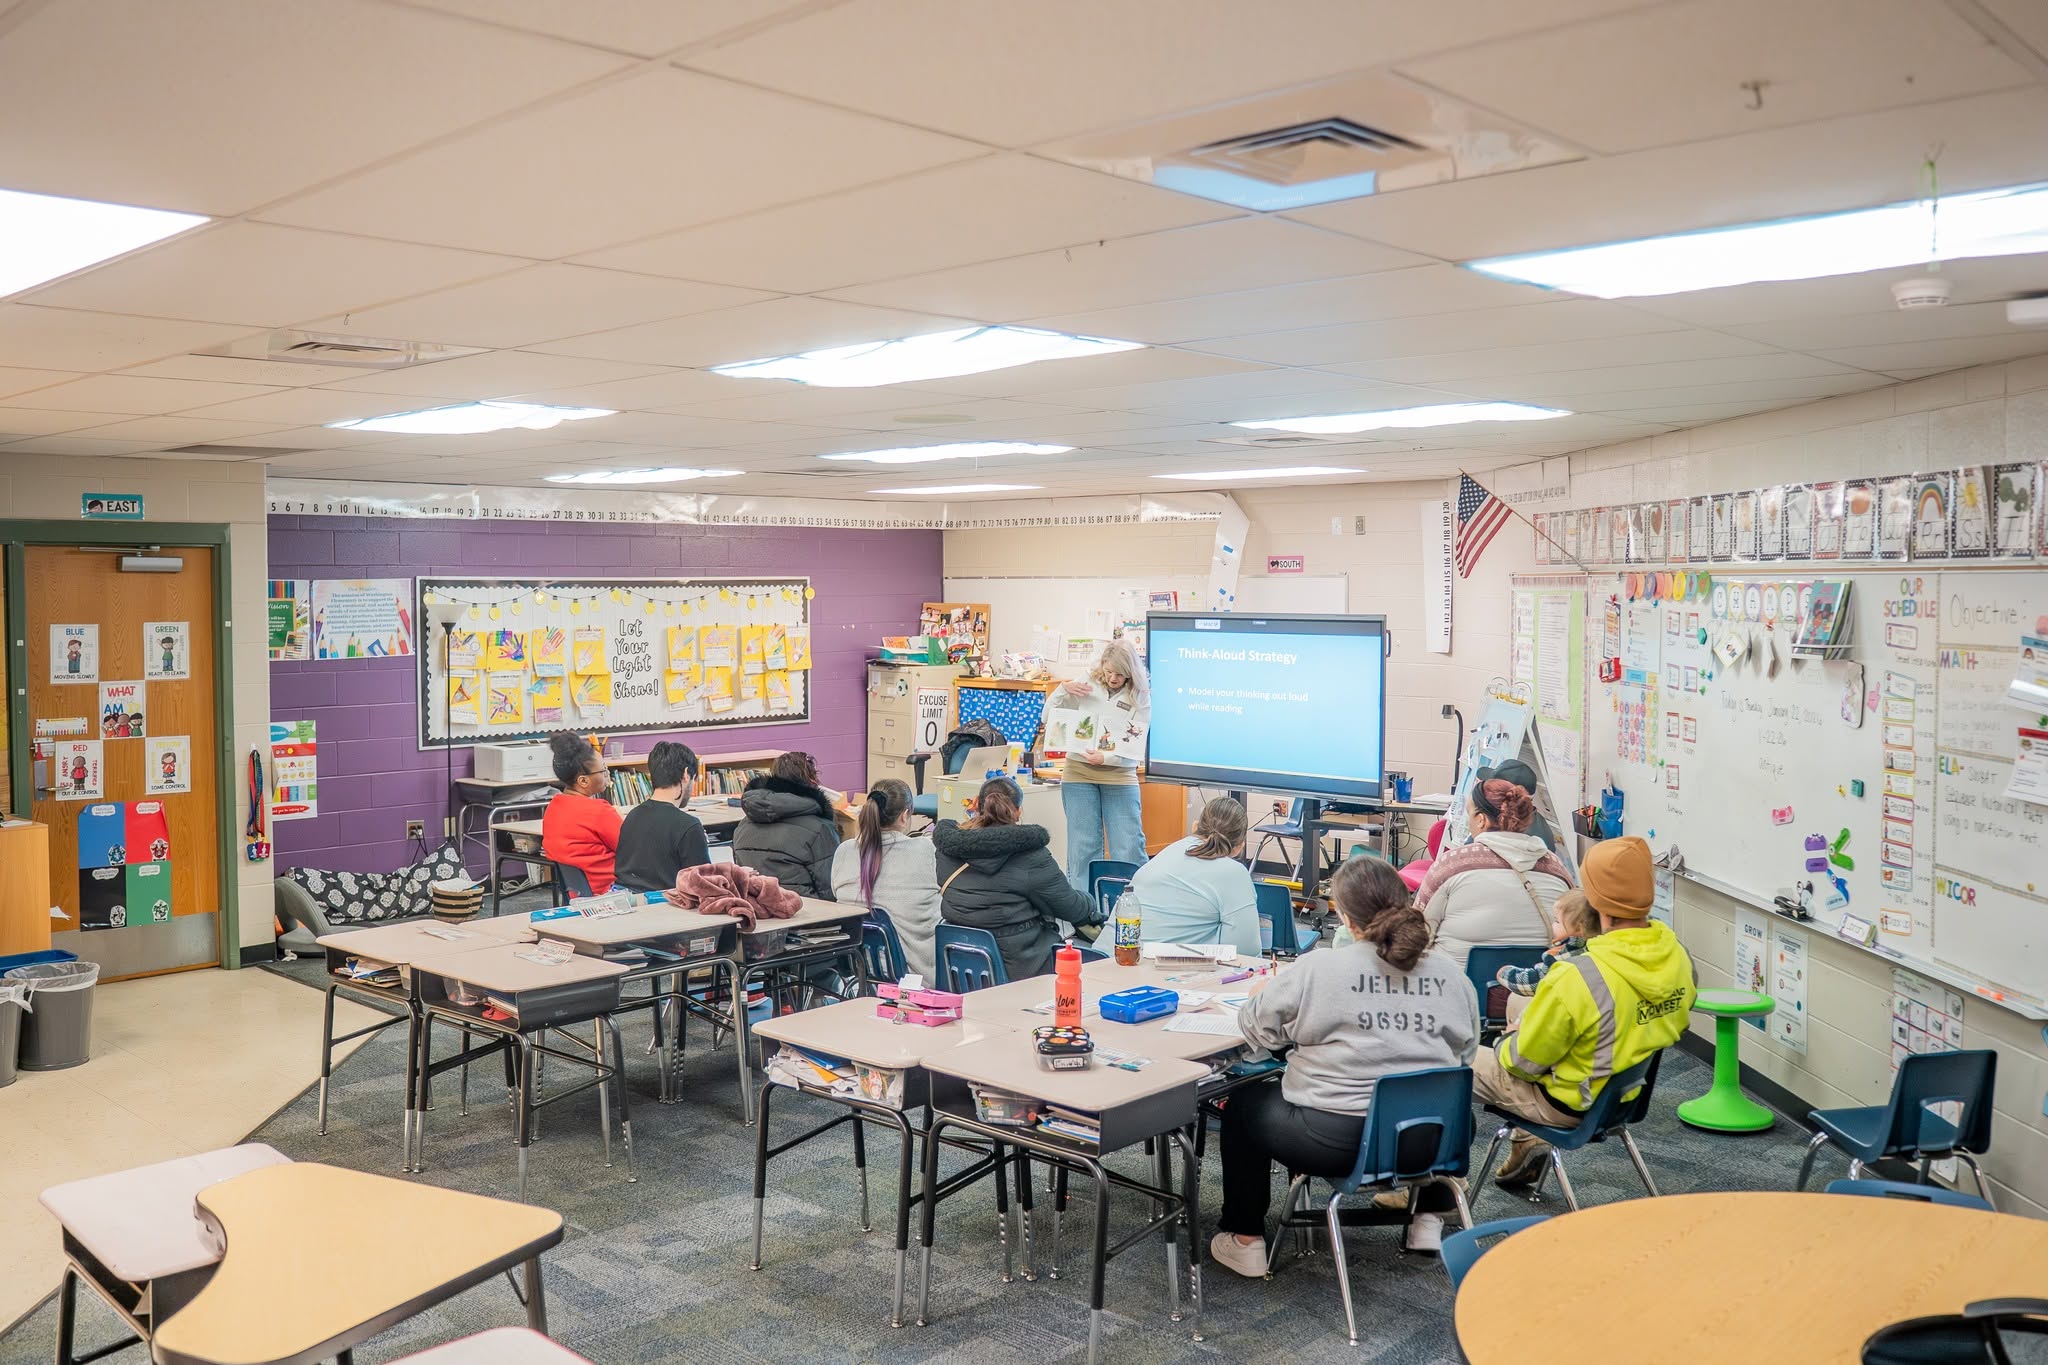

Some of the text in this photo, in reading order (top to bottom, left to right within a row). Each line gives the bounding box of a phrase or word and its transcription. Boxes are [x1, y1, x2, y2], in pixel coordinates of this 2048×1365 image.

[107, 501, 137, 512] EAST
[271, 502, 276, 512] 5
[286, 502, 291, 512] 6
[300, 503, 305, 512] 7
[313, 503, 319, 513] 8
[327, 504, 332, 513] 9
[341, 504, 348, 514] 10
[355, 505, 360, 514] 11
[482, 508, 489, 517] 21
[494, 508, 502, 518] 22
[553, 510, 561, 519] 27
[564, 511, 572, 520] 28
[576, 511, 583, 520] 29
[588, 511, 596, 520] 30
[609, 512, 616, 521] 32
[620, 512, 627, 521] 33
[946, 520, 954, 528] 68
[1279, 560, 1301, 568] SOUTH
[1443, 557, 1451, 568] 116
[1901, 577, 1923, 597] OUR
[1883, 600, 1937, 618] SCHEDULE
[65, 628, 85, 636] BLUE
[619, 618, 643, 637] Let
[614, 637, 649, 656] Your
[1178, 648, 1298, 665] Think-Aloud Strategy
[612, 654, 652, 680] Light
[107, 686, 136, 697] WHAT
[613, 679, 659, 700] Shine!
[1188, 687, 1309, 702] Model your thinking out loud
[104, 703, 124, 714] AM
[919, 695, 948, 706] EXCUSE
[922, 708, 943, 719] LIMIT
[1188, 703, 1244, 715] while reading
[925, 721, 938, 747] 0
[72, 744, 88, 752] RED
[1936, 876, 1976, 907] WICOR
[1744, 924, 1763, 939] GROW
[1351, 974, 1446, 997] JELLEY
[1357, 1011, 1436, 1033] 96933
